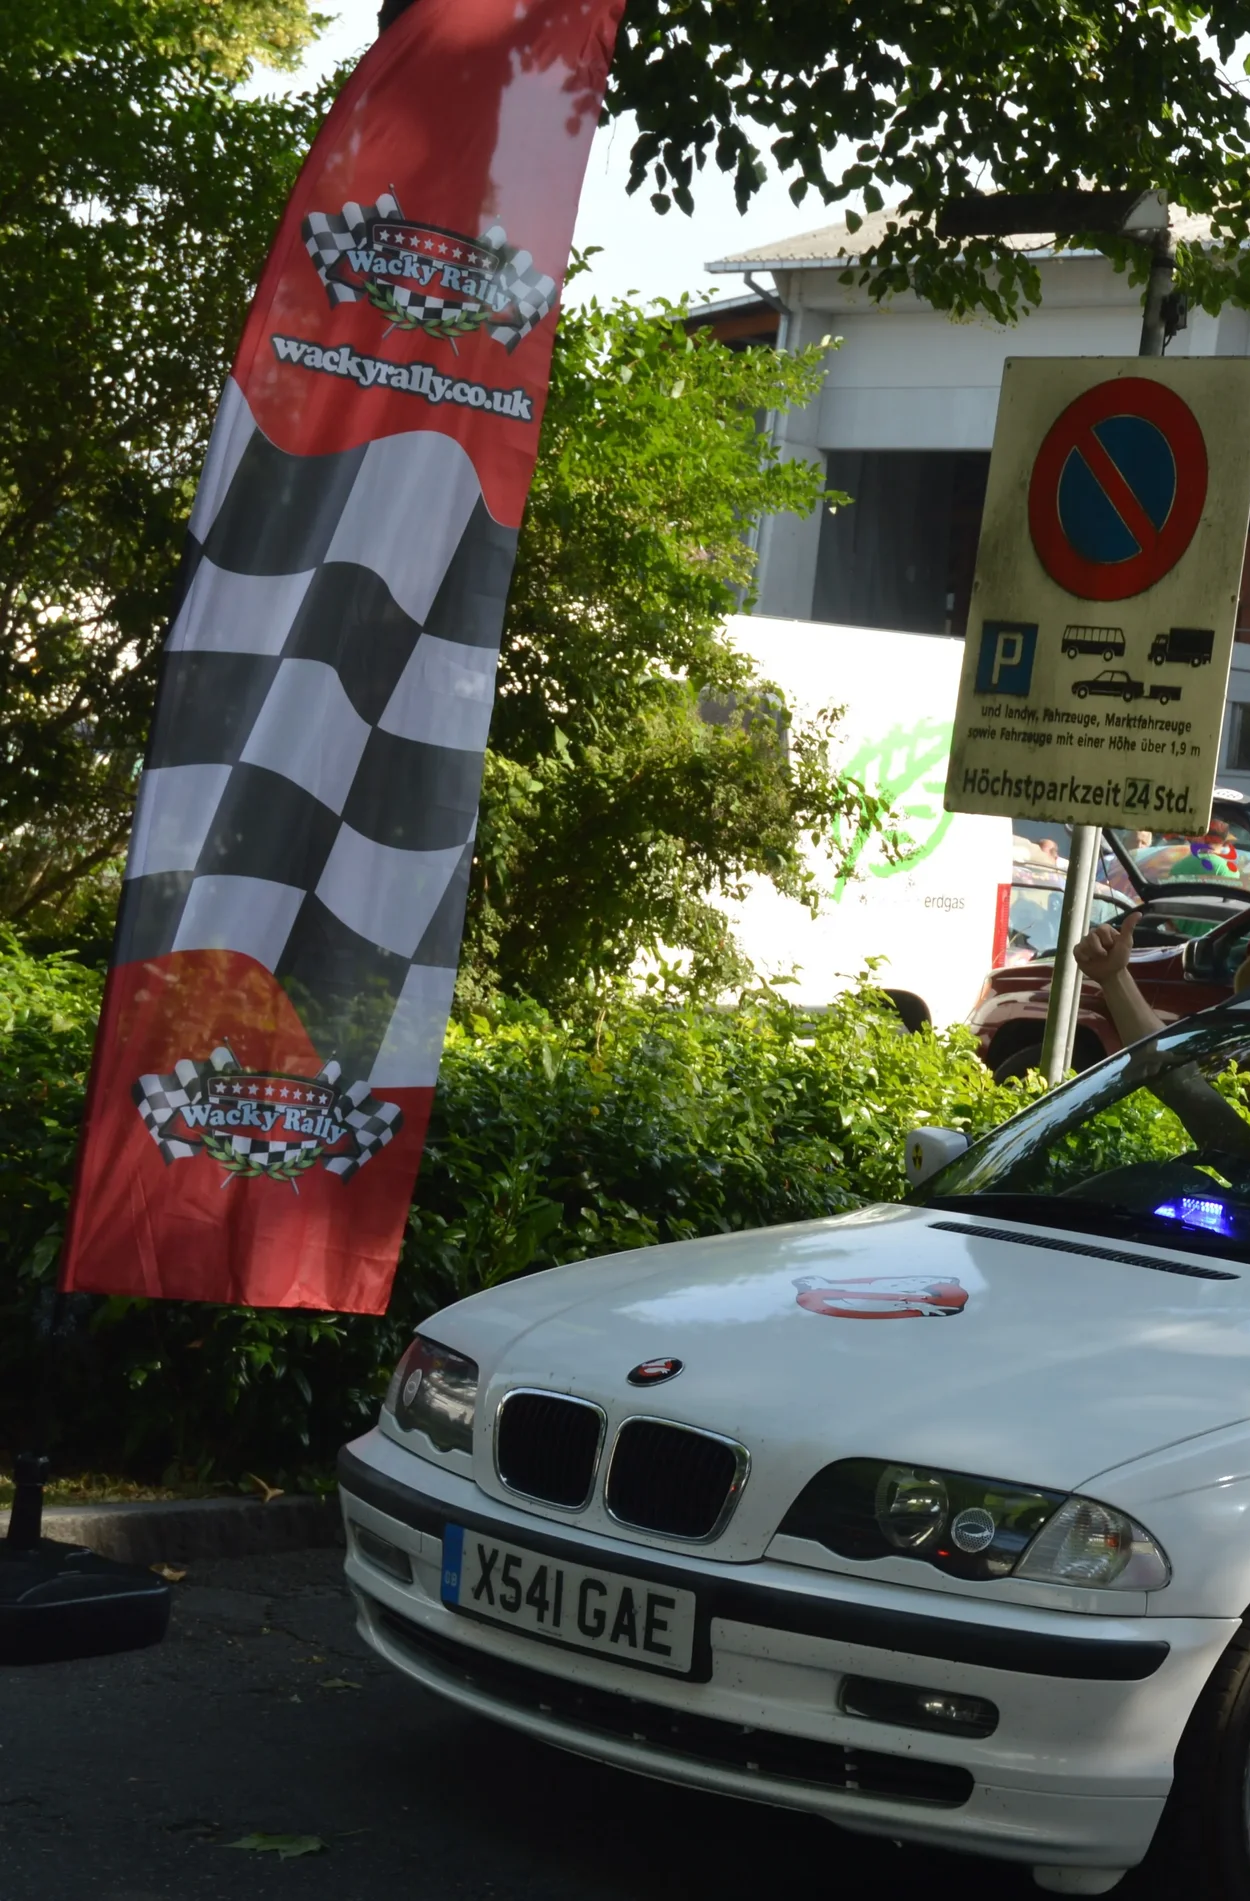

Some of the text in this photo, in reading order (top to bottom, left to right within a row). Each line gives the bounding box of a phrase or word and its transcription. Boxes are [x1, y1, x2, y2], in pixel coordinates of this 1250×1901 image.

[346, 250, 511, 313] Wacky Rally
[272, 336, 533, 421] wackyrally.co.uk
[967, 726, 1200, 756] sowie Fahrzeuge mit einer Höhe über 1,9 m
[981, 704, 1001, 718] und
[1043, 710, 1100, 728] Fahrzeuge,
[1104, 714, 1192, 736] Marktfahrzeuge
[963, 769, 1194, 814] Höchstparkzeit 24 Std.
[924, 894, 966, 912] erdgas
[180, 1103, 348, 1145] Wacky Rally
[473, 1543, 676, 1656] X541 GAE
